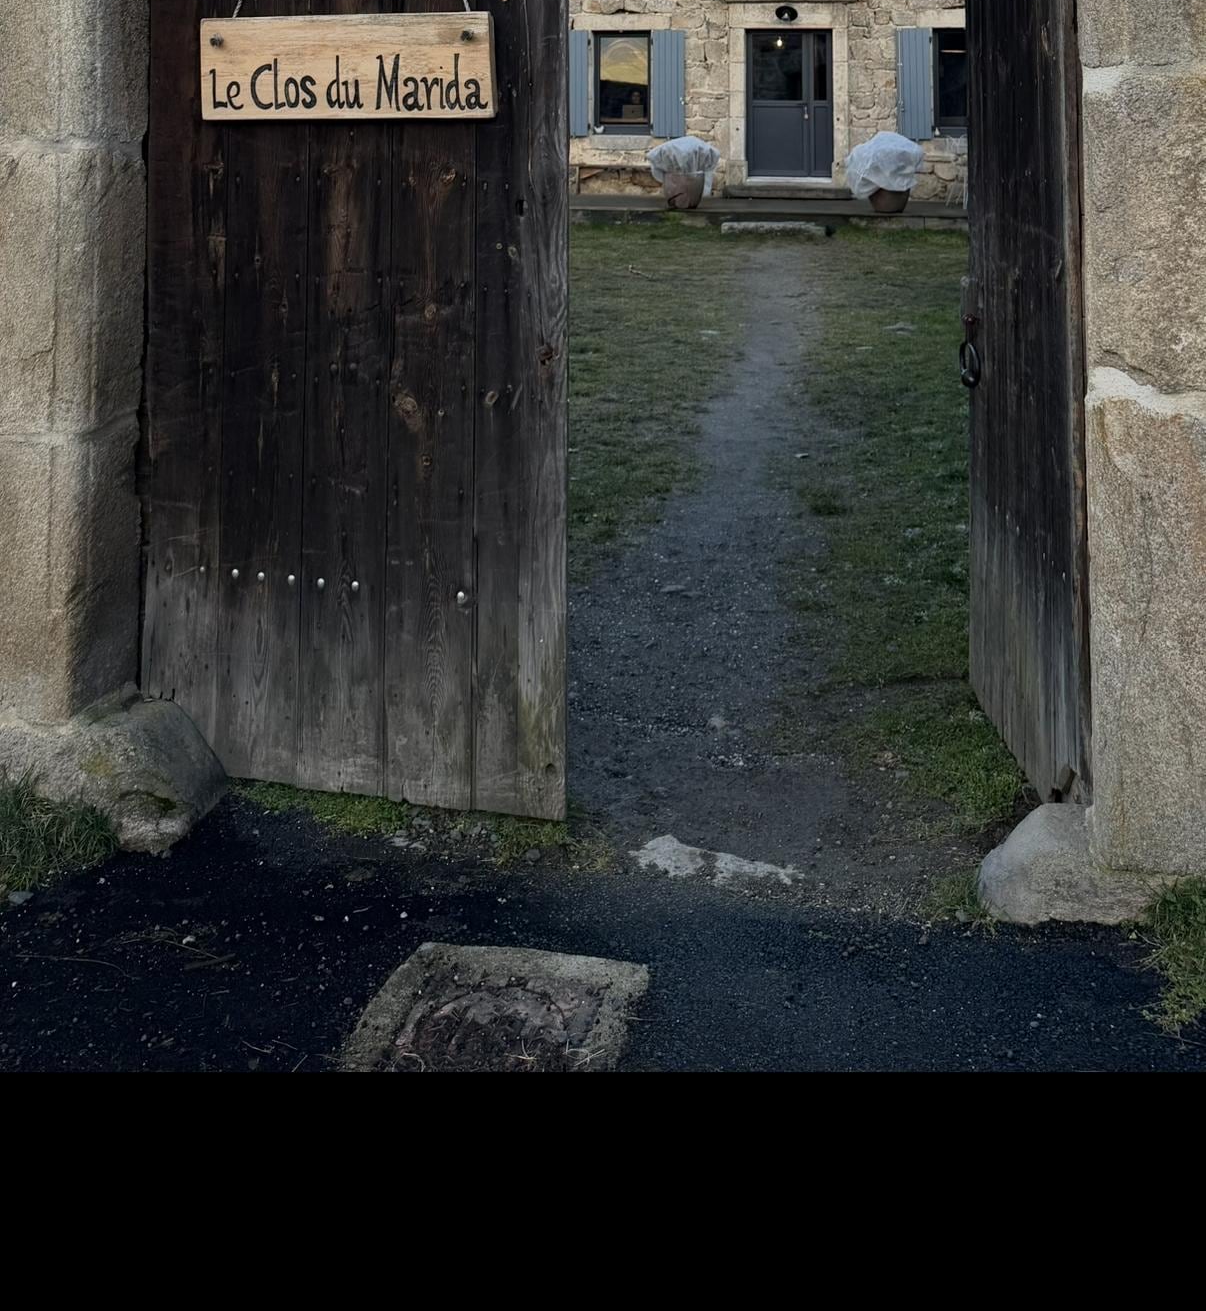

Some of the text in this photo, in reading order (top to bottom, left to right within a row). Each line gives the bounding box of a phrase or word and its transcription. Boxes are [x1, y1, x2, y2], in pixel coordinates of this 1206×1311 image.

[208, 53, 488, 111] Le Clos du Marida
